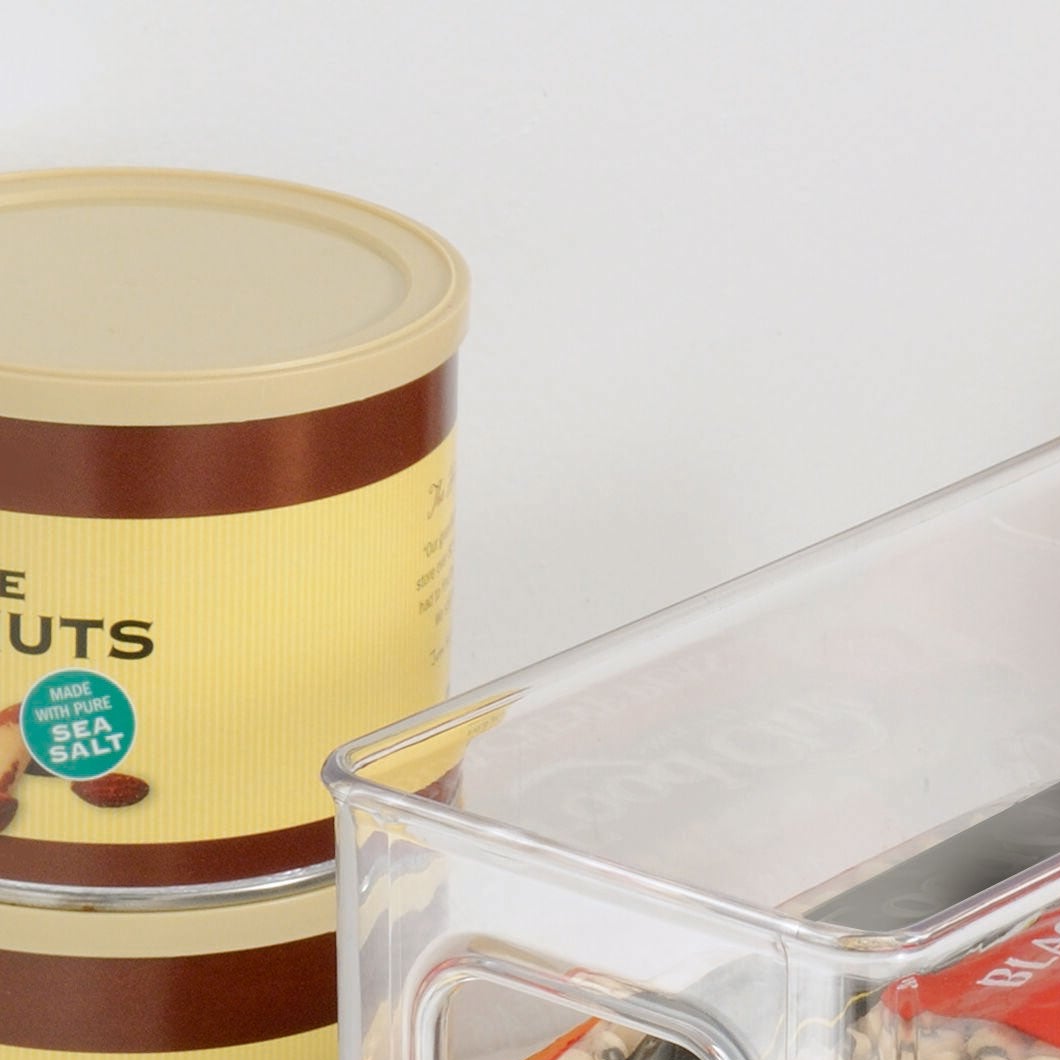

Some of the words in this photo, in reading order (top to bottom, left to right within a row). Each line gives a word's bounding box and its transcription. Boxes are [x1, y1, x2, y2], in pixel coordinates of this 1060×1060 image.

[49, 681, 92, 702] MADE
[34, 705, 70, 723] WITH
[74, 695, 112, 717] PURE
[51, 716, 112, 743] SEA
[49, 733, 124, 764] SALT
